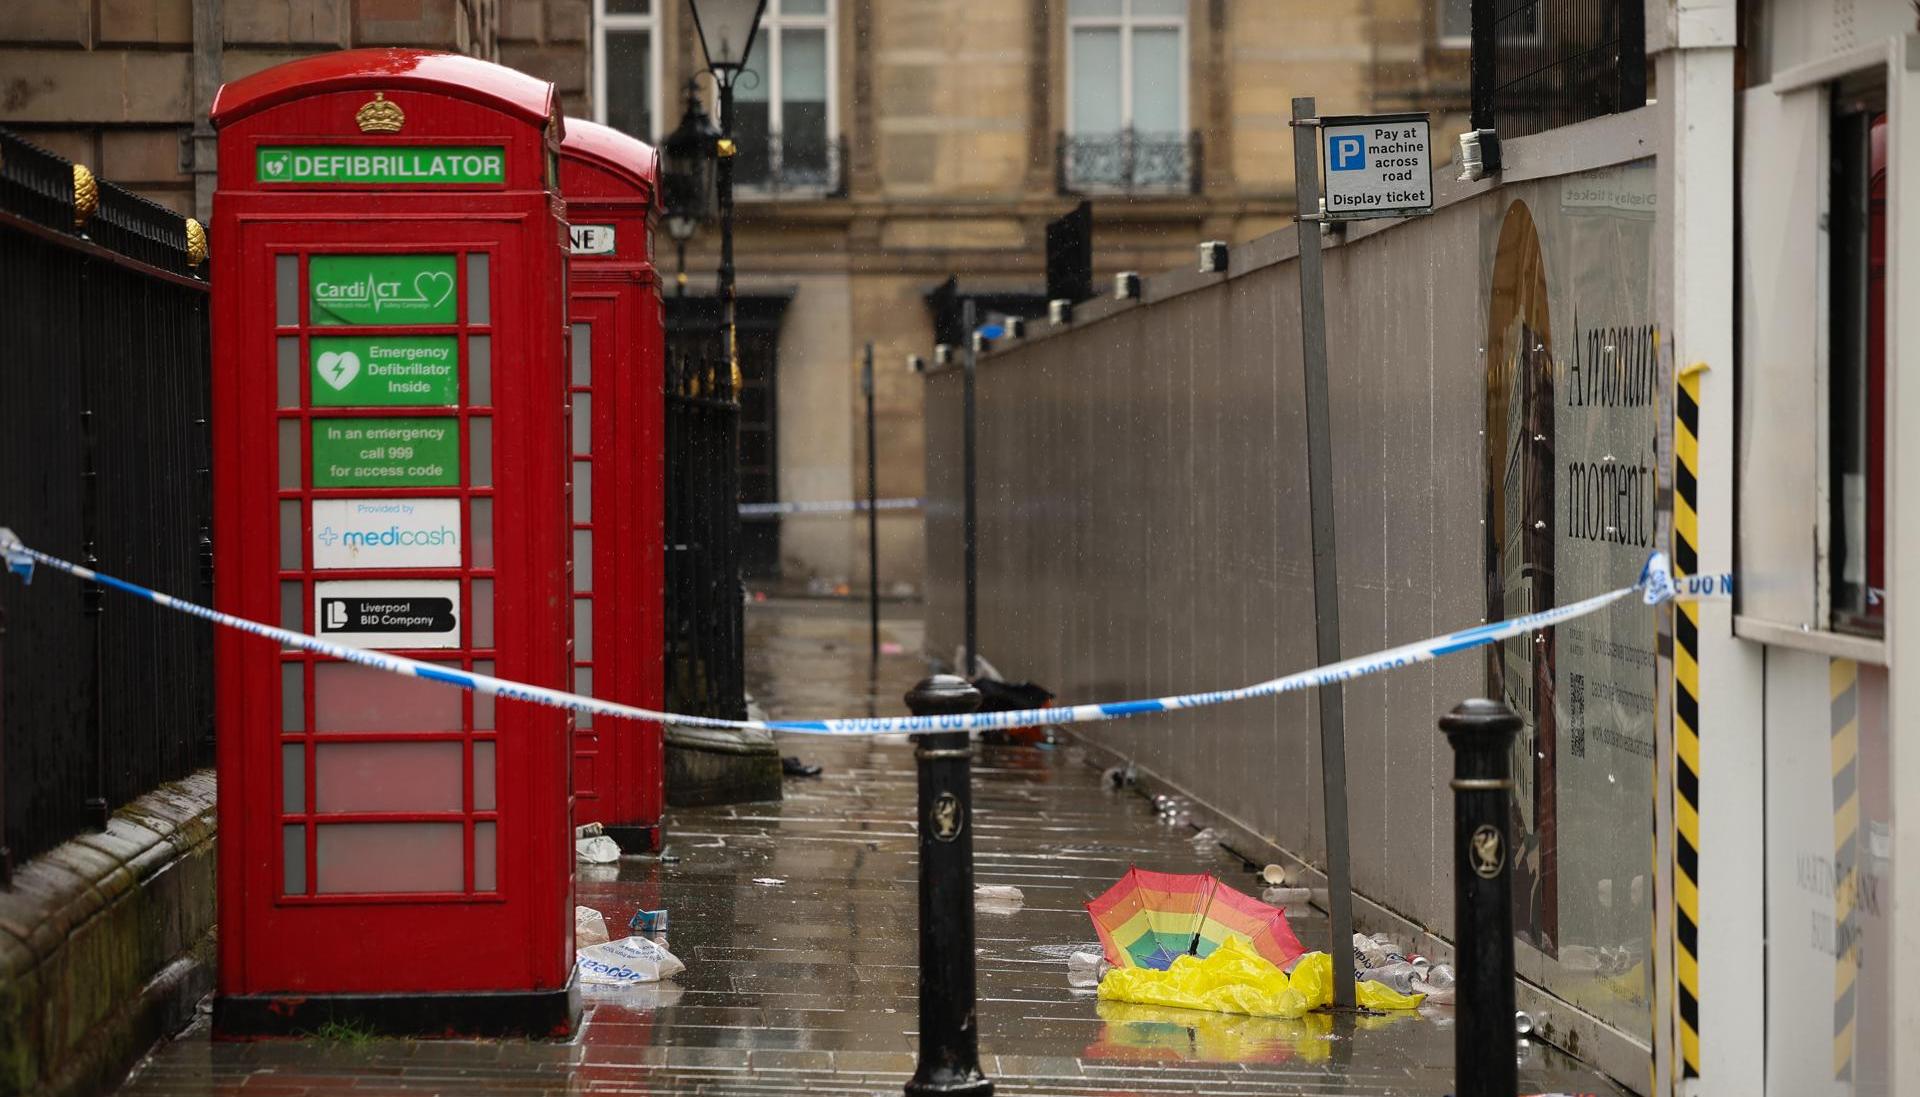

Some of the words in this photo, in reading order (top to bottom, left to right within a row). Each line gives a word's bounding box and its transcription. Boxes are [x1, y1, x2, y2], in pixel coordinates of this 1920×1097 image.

[1375, 128, 1398, 141] Pay
[1403, 127, 1416, 138] at
[1338, 139, 1360, 168] P
[1368, 142, 1424, 154] machine
[294, 155, 501, 176] DEFIBRILLATOR
[1375, 157, 1418, 168] across
[1382, 170, 1412, 182] road
[1333, 193, 1382, 206] Display
[1386, 190, 1425, 202] ticket
[369, 346, 449, 360] Emergency
[368, 364, 451, 376] Defibrillator
[388, 380, 431, 393] Inside
[327, 427, 341, 440] In
[345, 429, 362, 440] an
[366, 427, 445, 440] emergency
[360, 447, 384, 459] call
[388, 446, 414, 459] 999
[330, 465, 350, 477] for
[354, 466, 404, 477] access
[408, 464, 443, 476] code
[357, 503, 399, 514] Provided
[402, 503, 414, 515] by
[343, 525, 456, 546] medicash
[360, 602, 410, 614] Liverpool
[360, 615, 379, 625] BID
[381, 615, 434, 627] Company
